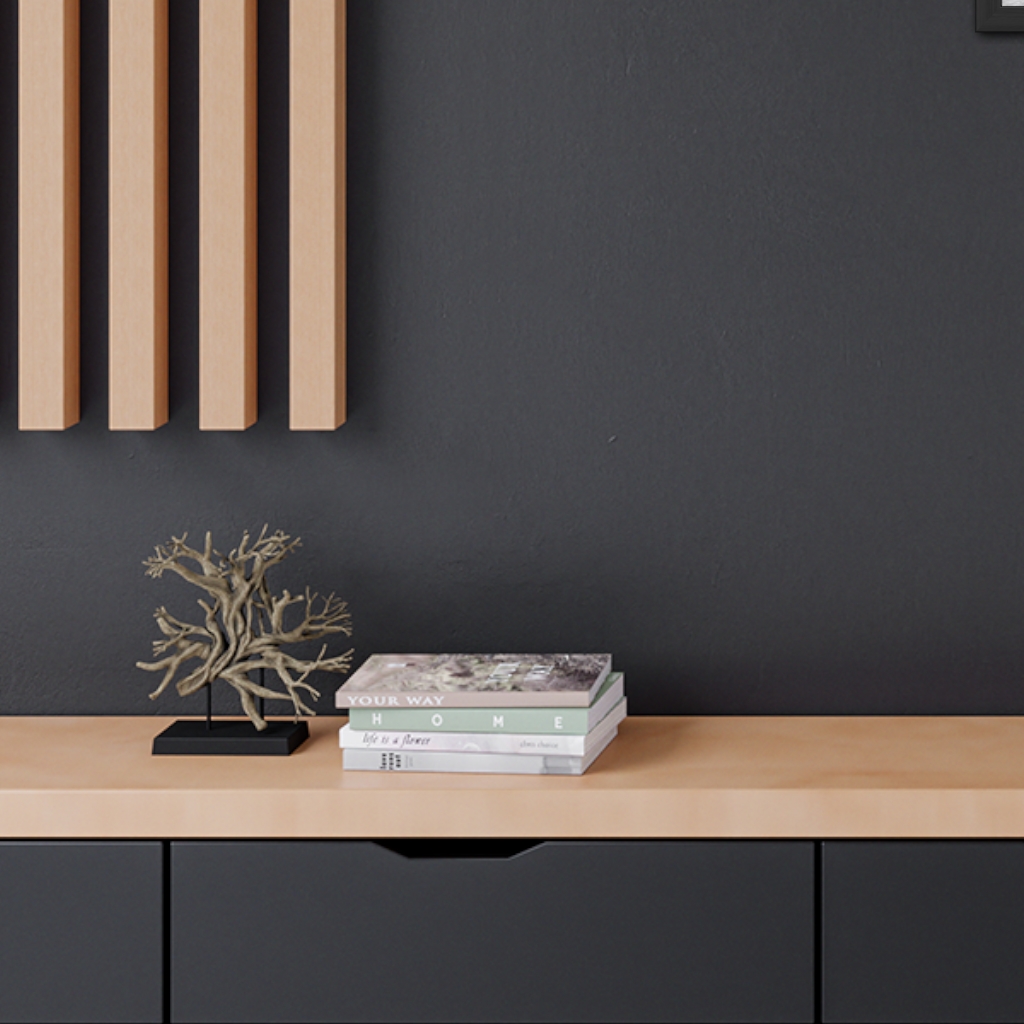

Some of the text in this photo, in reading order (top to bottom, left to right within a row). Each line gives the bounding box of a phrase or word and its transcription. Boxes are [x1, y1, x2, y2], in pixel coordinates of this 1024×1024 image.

[347, 696, 445, 706] YOUR WAY
[400, 733, 431, 748] flower
